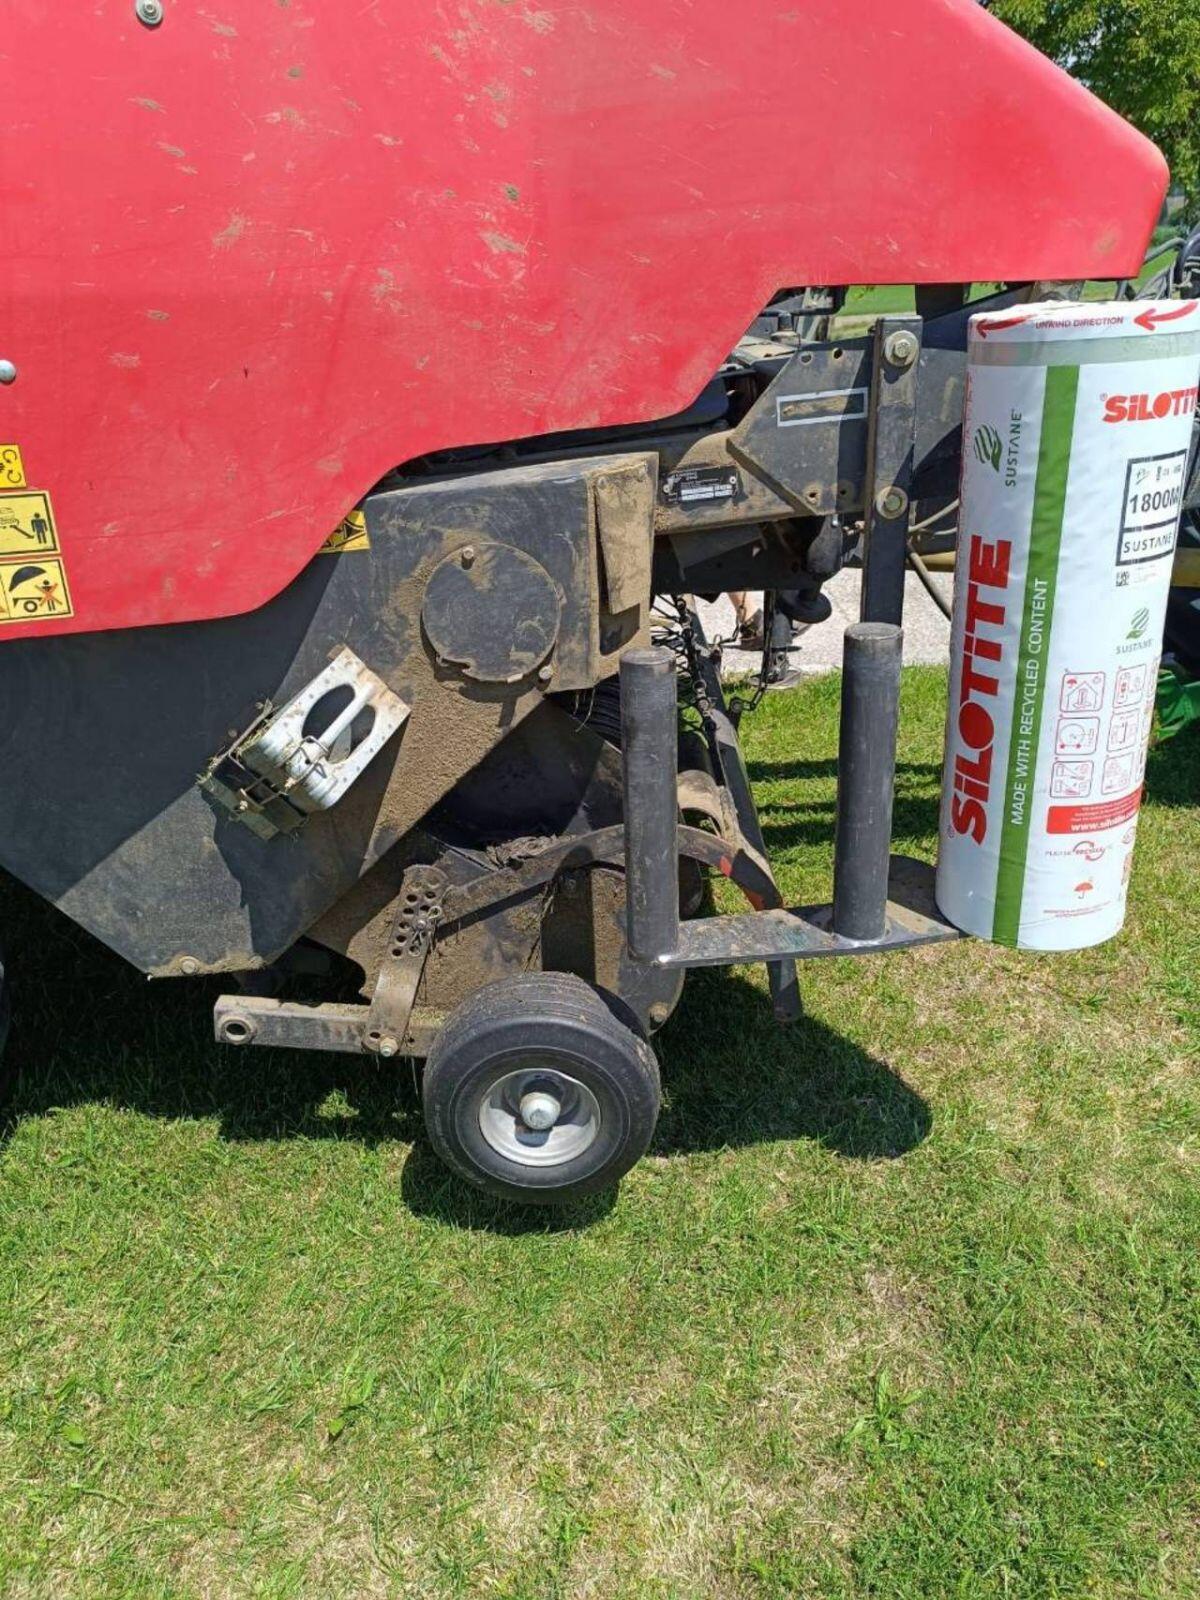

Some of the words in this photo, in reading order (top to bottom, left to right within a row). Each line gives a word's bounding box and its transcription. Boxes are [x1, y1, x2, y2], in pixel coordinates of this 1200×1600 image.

[1035, 319, 1071, 329] UNWIND
[1073, 316, 1124, 327] DIRECTION
[1005, 408, 1022, 487] SUSTANE
[1129, 486, 1181, 514] 1800M
[1123, 532, 1173, 554] SUSTANE
[1028, 577, 1048, 655] CONTENT
[1020, 659, 1040, 735] RECYCLED
[1016, 740, 1031, 778] WITH
[1011, 781, 1027, 825] MADE
